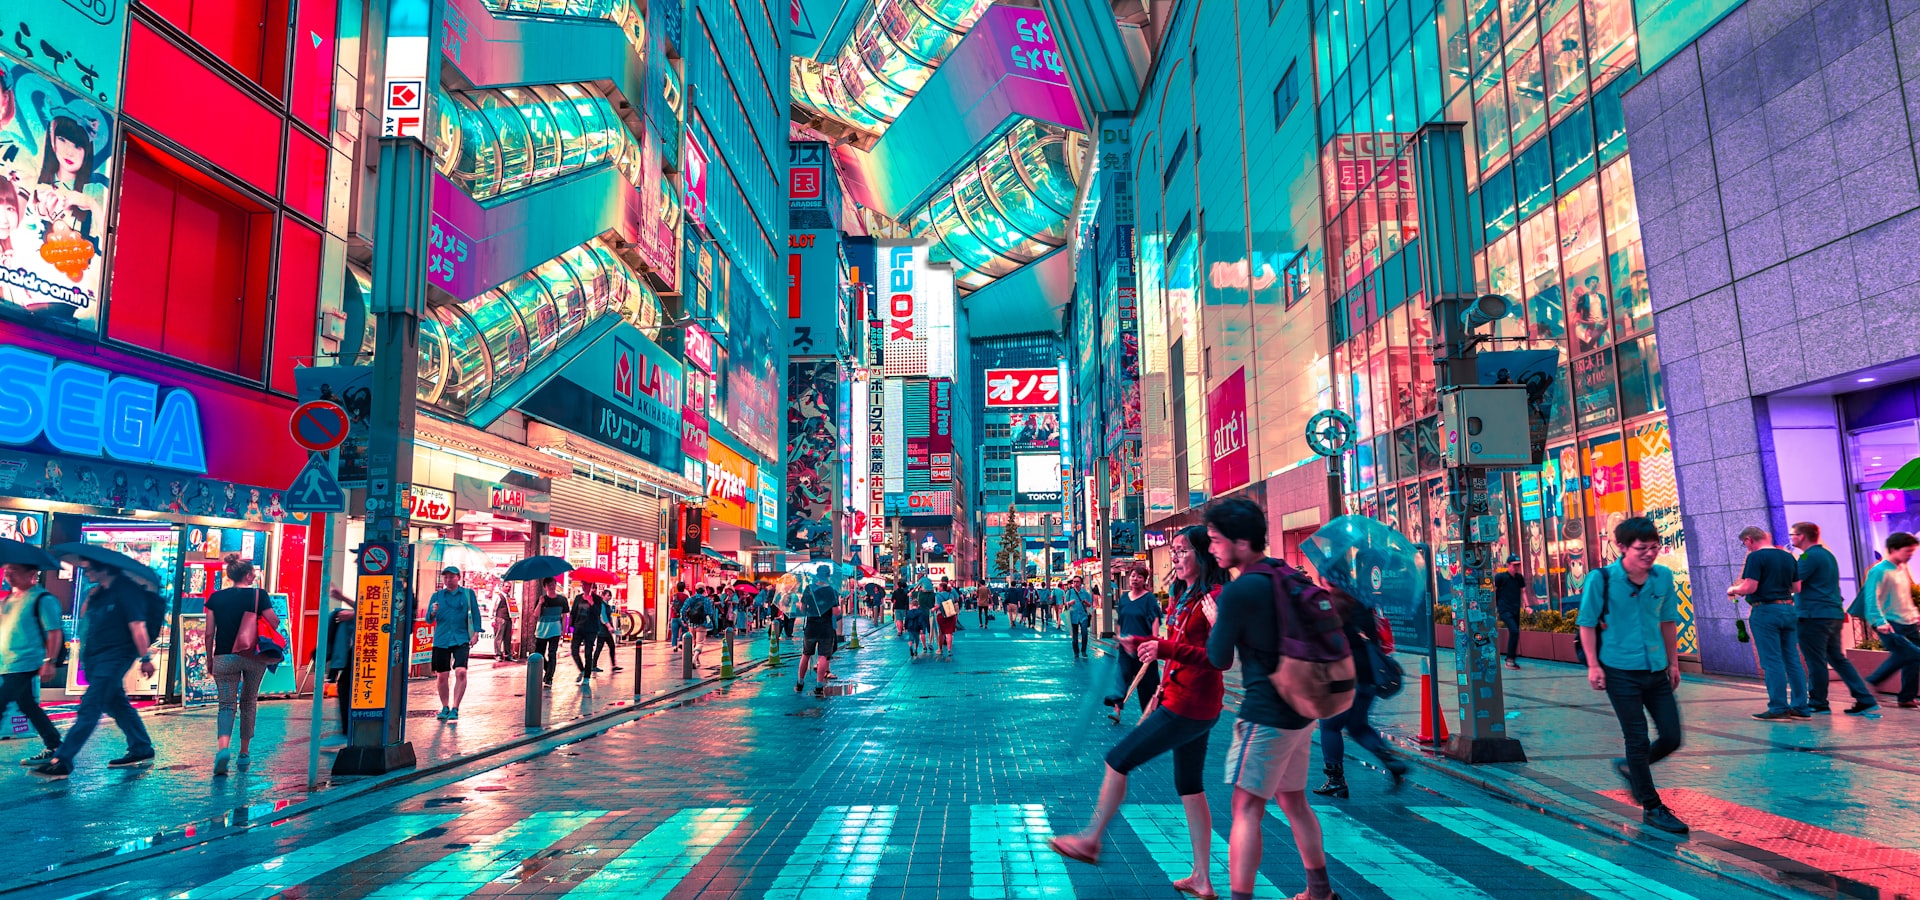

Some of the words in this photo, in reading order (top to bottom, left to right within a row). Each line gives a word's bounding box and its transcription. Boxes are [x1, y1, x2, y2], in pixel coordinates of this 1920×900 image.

[0, 22, 107, 102] らです。
[431, 223, 468, 262] カメラ
[638, 352, 681, 414] LABI
[0, 345, 207, 475] SEGA
[600, 407, 651, 455] パソコン館
[638, 398, 680, 433] AKIHABARA
[1214, 410, 1239, 458] atré
[503, 488, 525, 506] LABI
[362, 586, 382, 704] 路上喫煙禁止です。
[416, 626, 435, 639] au
